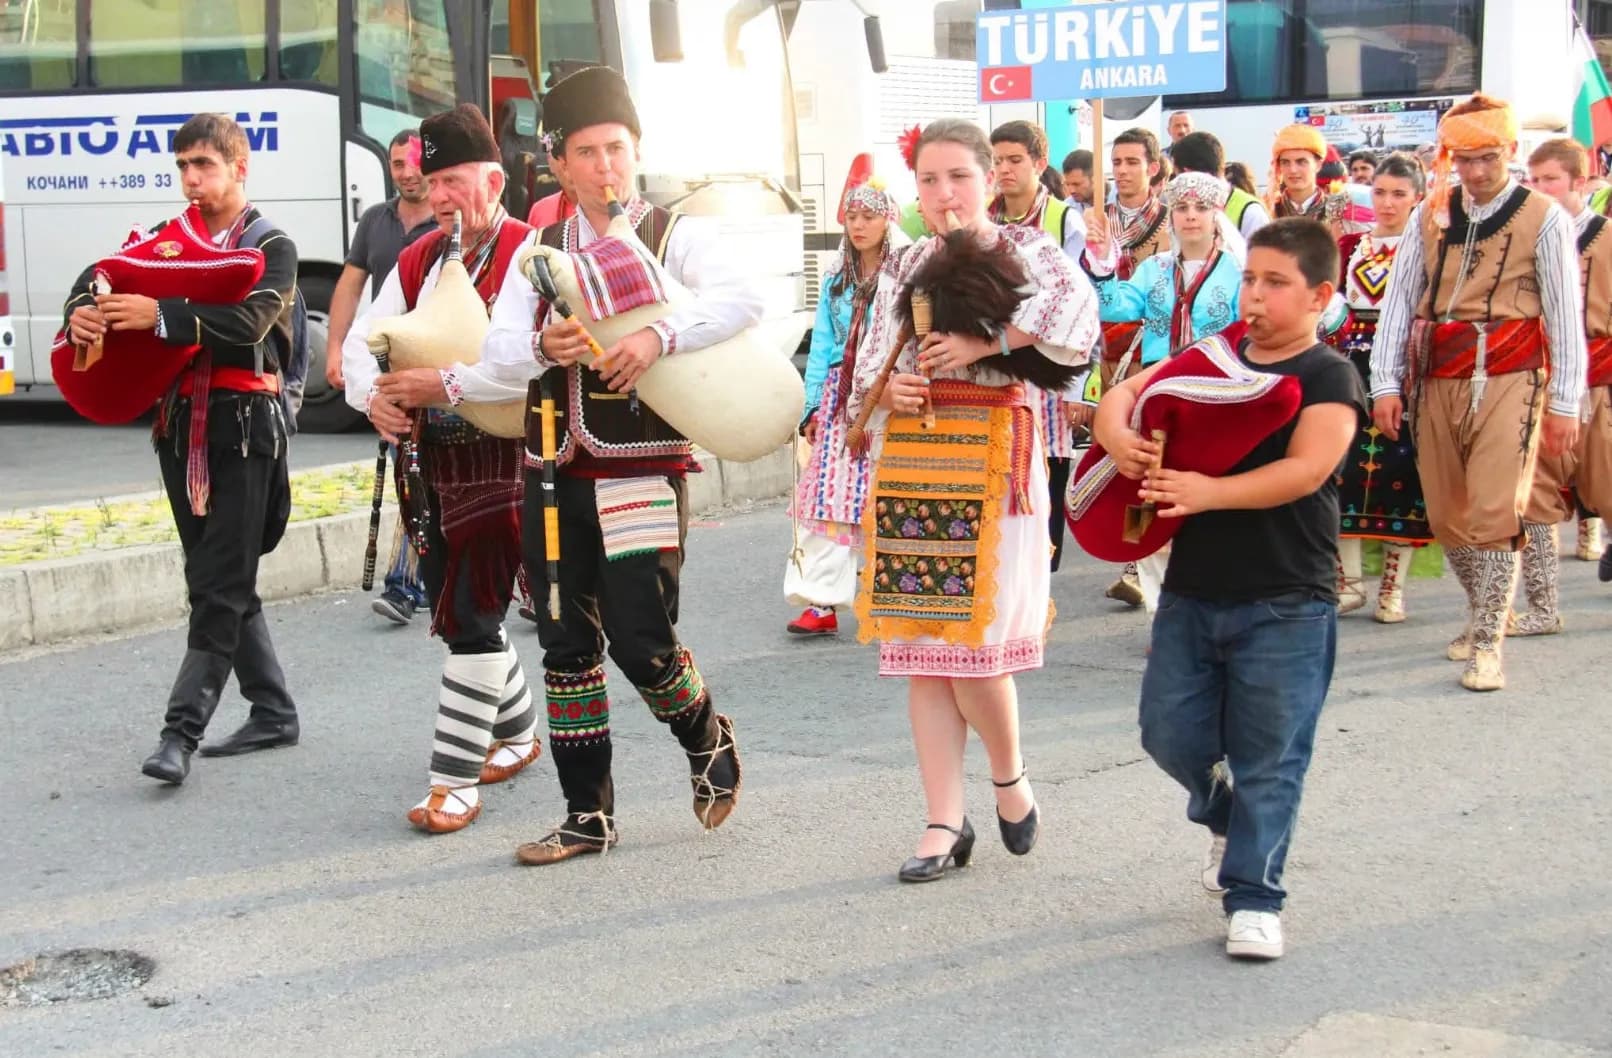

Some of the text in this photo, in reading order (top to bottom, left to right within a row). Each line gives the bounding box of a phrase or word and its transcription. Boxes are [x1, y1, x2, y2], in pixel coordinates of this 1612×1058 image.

[1080, 64, 1167, 90] ANKARA
[27, 175, 88, 190] КОЧАНИ
[155, 173, 171, 187] 33
